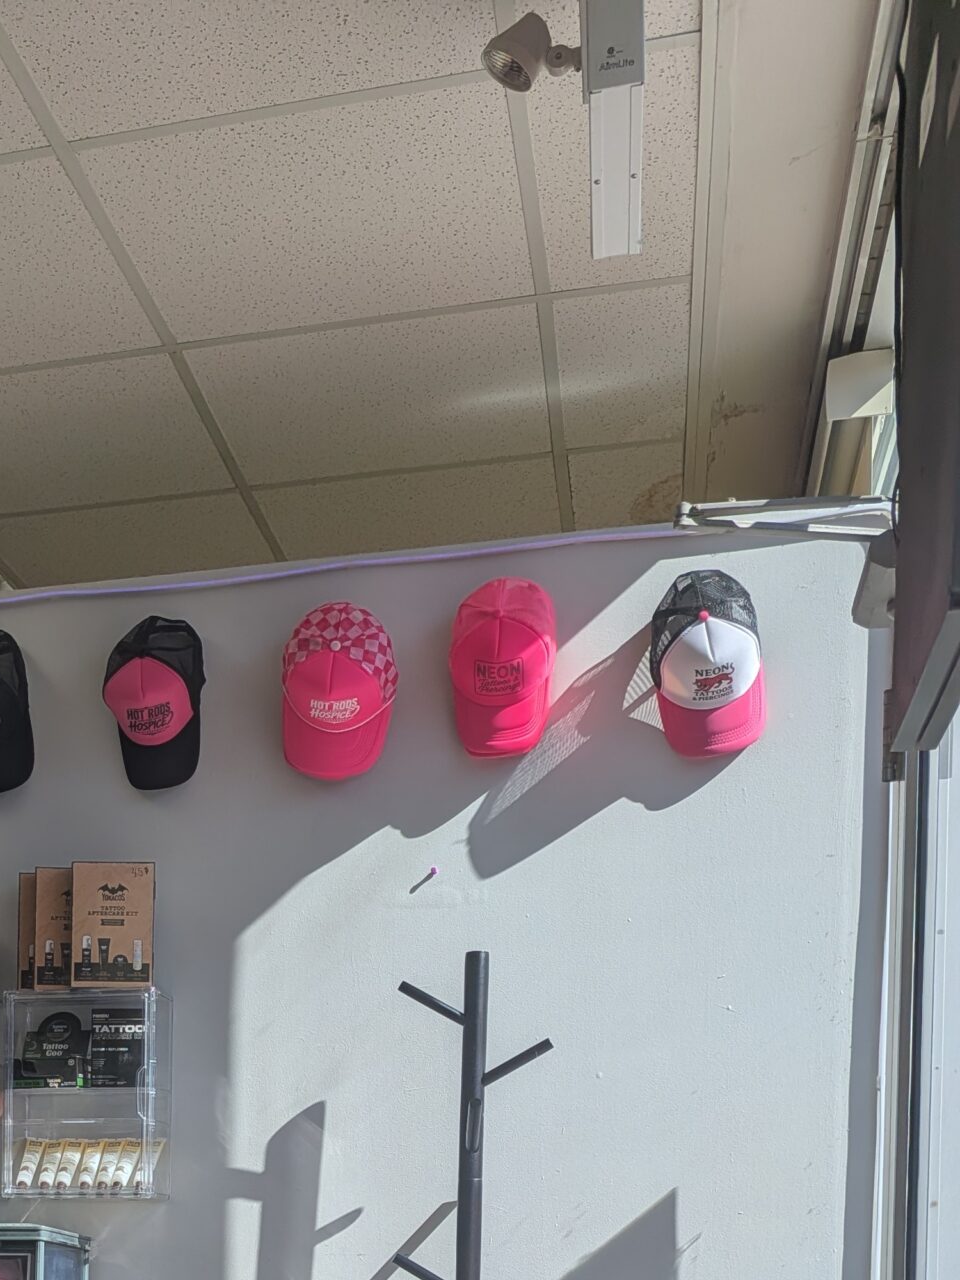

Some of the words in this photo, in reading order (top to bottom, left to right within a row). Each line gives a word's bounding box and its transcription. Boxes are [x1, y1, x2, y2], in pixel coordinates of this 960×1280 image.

[476, 661, 521, 680] NEON
[695, 662, 730, 677] NEON
[694, 685, 733, 697] TATTOOS
[126, 708, 145, 721] HOT
[147, 701, 171, 719] RODS
[309, 705, 360, 719] HOSPICE
[310, 699, 330, 710] HOT
[333, 698, 358, 711] RODS
[128, 710, 174, 733] HOSPICE
